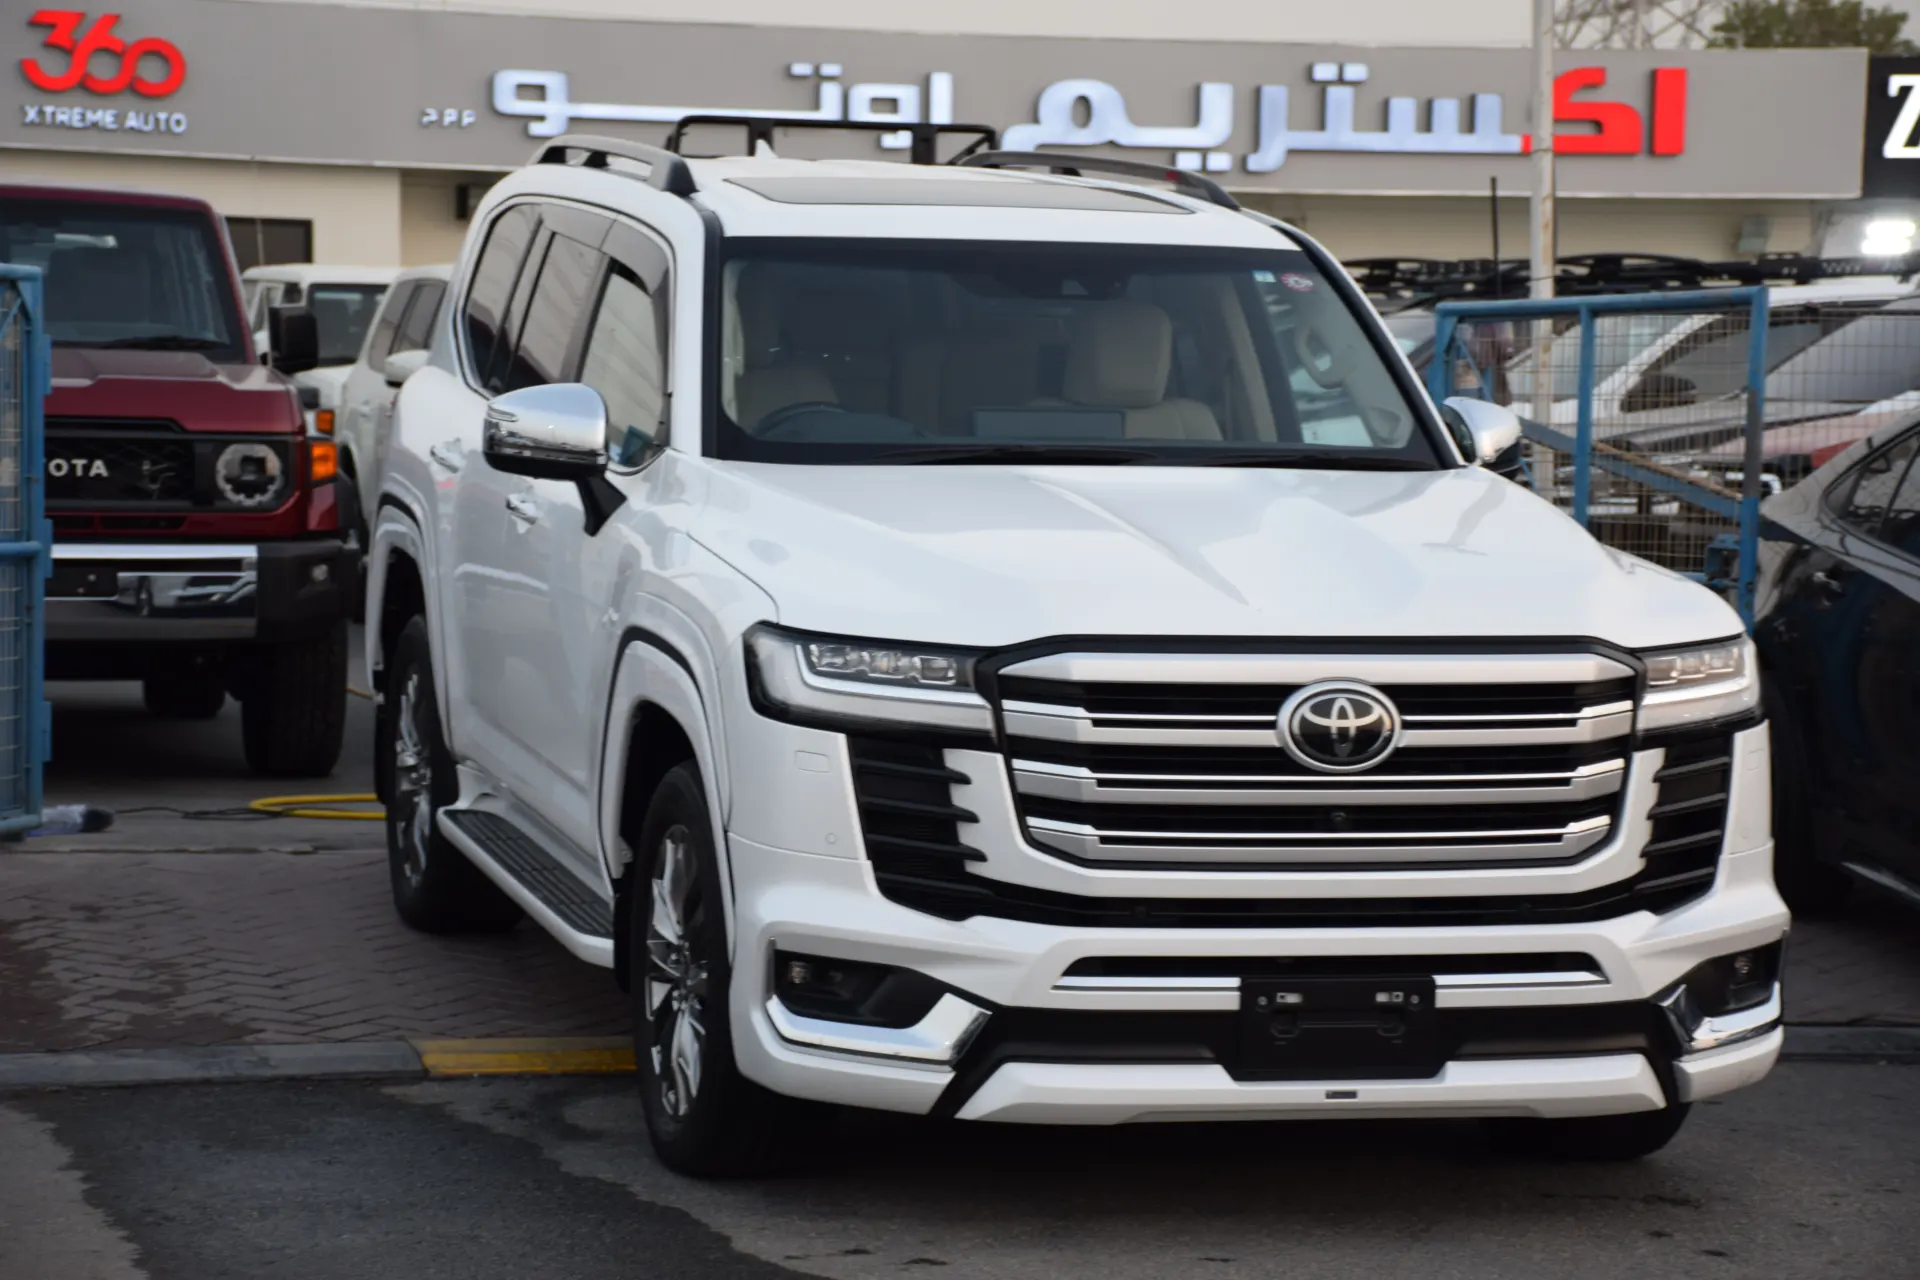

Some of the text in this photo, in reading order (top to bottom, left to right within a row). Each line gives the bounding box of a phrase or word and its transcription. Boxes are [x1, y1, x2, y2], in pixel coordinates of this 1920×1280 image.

[20, 9, 187, 98] 360
[25, 105, 188, 133] XTREME AUTO
[43, 458, 109, 477] OTA
